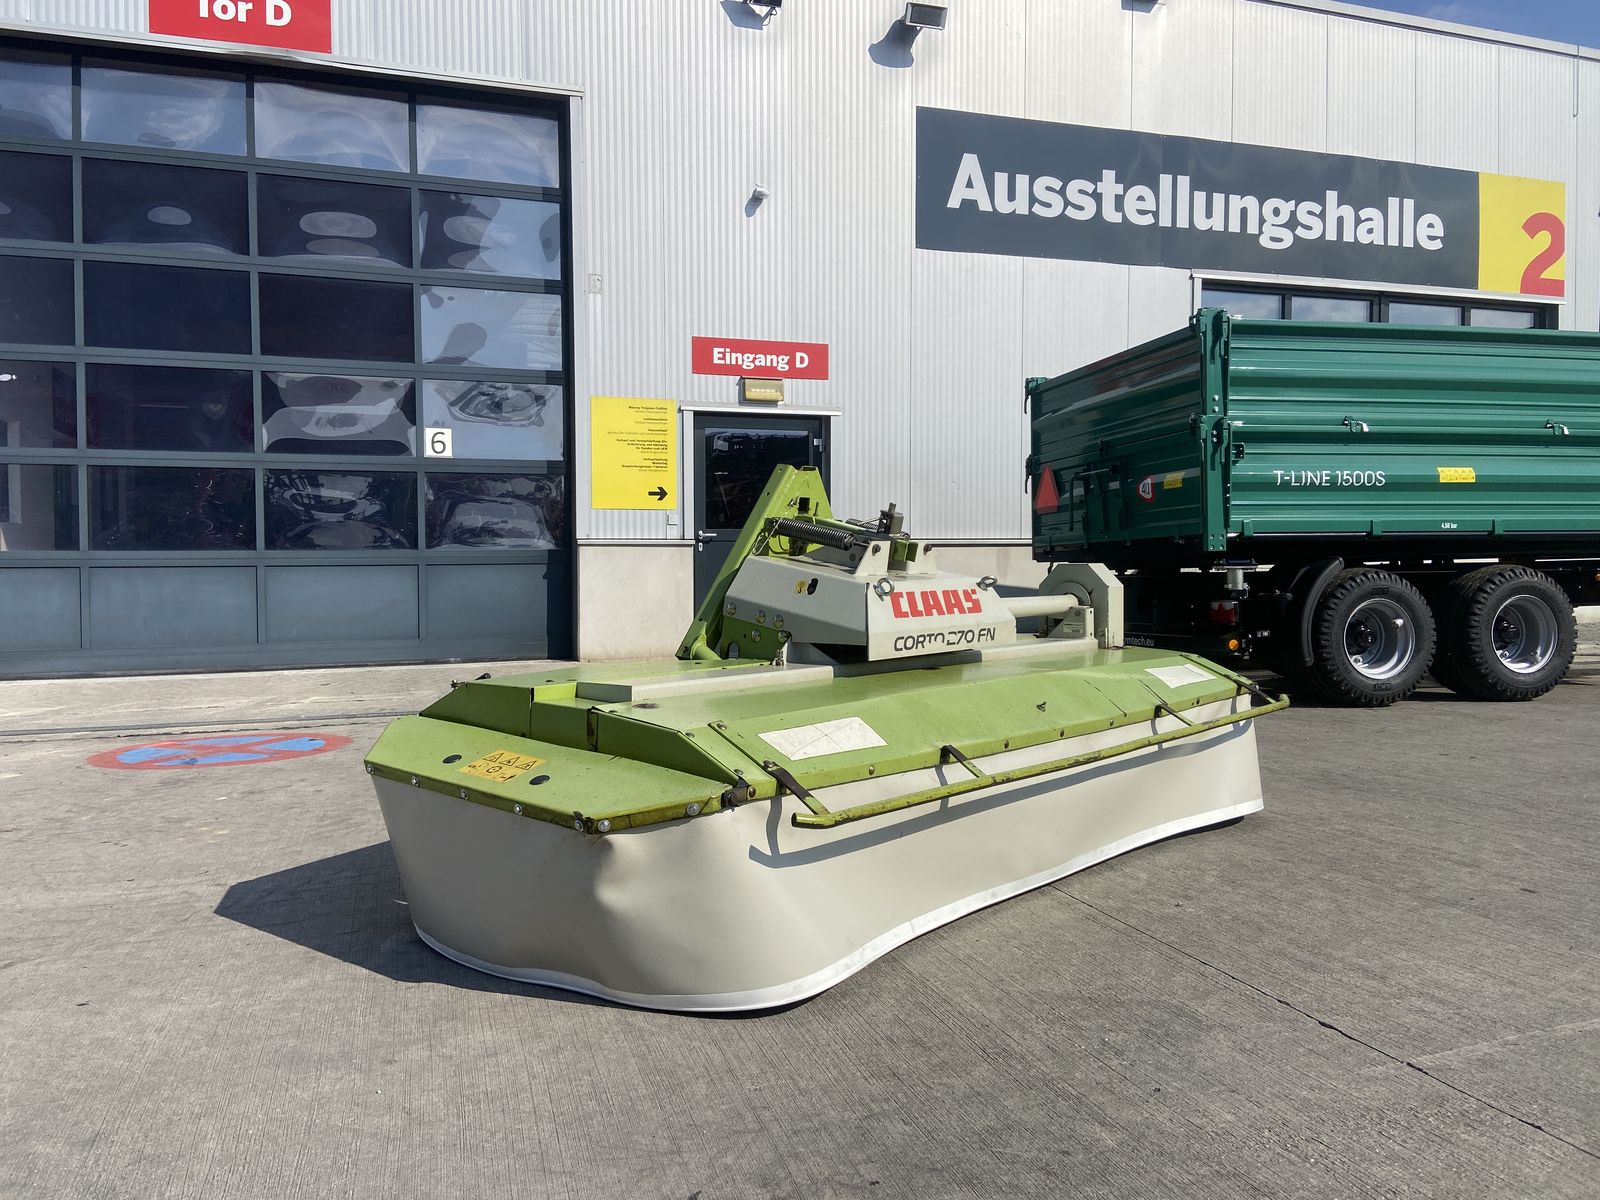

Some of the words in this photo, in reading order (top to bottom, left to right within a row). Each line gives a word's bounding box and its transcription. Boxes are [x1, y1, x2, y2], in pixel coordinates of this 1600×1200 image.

[200, 0, 253, 22] Tor
[266, 0, 292, 27] D
[946, 152, 1444, 250] Ausstellungshalle
[1520, 211, 1565, 297] 2
[713, 347, 789, 371] Eingang
[795, 352, 809, 368] D
[431, 431, 446, 454] 6
[1141, 482, 1150, 494] 40
[1273, 470, 1331, 486] T-LINE
[1335, 470, 1386, 487] 1500S
[889, 589, 982, 619] CLAAS
[894, 632, 945, 652] CORTO
[978, 627, 996, 643] FN
